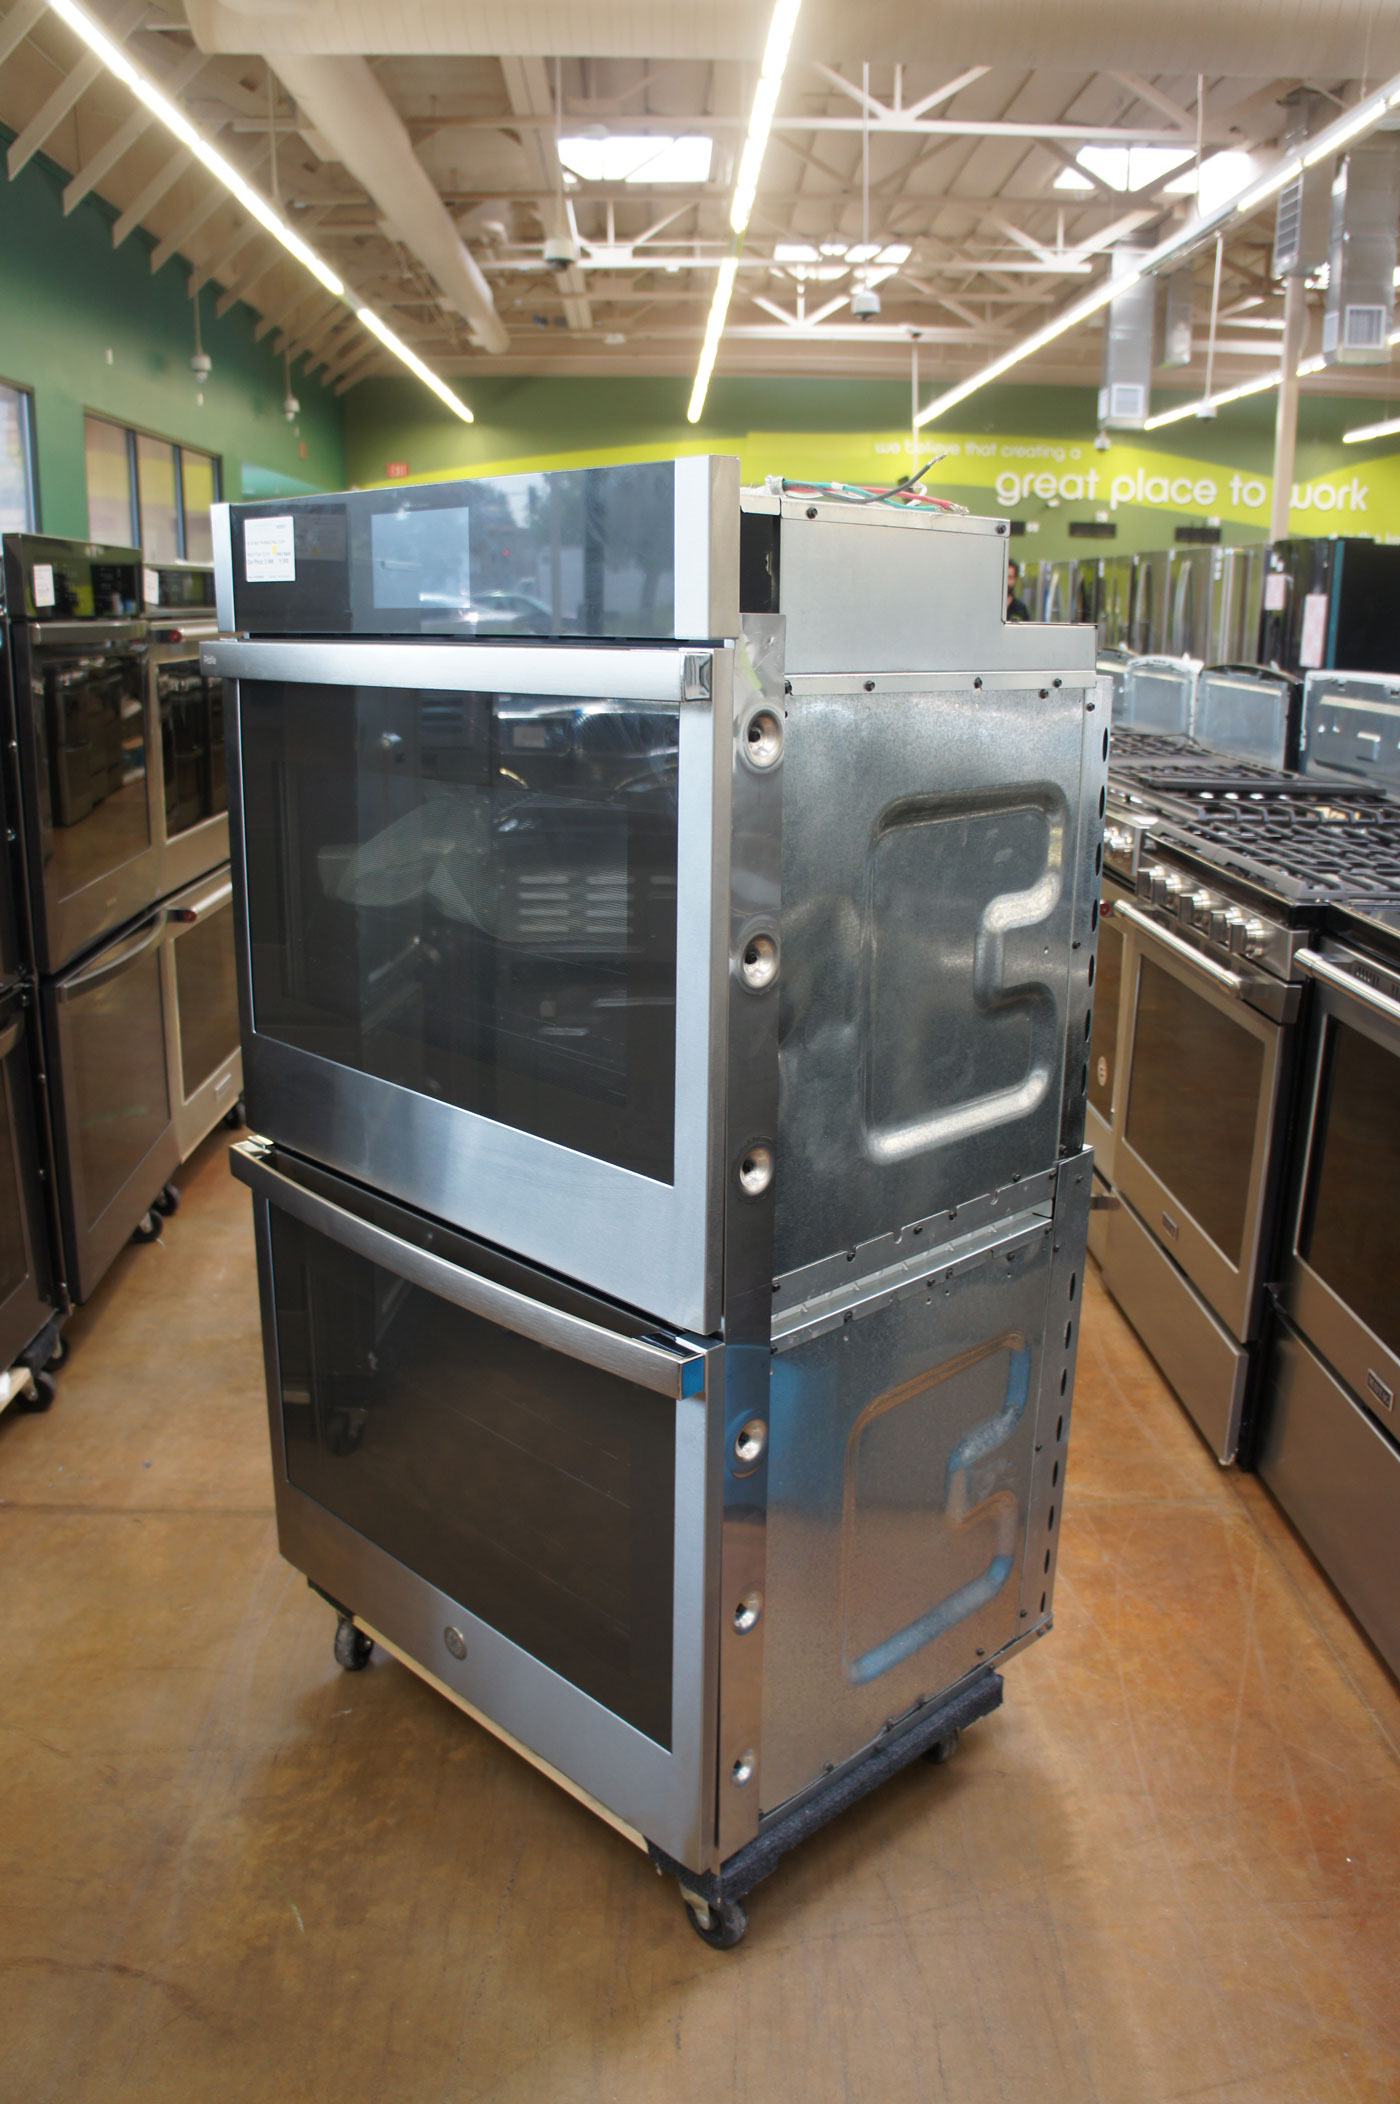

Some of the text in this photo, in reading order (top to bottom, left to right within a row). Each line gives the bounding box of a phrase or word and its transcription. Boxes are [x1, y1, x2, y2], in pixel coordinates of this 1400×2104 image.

[874, 439, 1081, 463] we believe that creating a
[995, 467, 1099, 507] great
[1110, 467, 1217, 511] place
[1229, 472, 1266, 508] to
